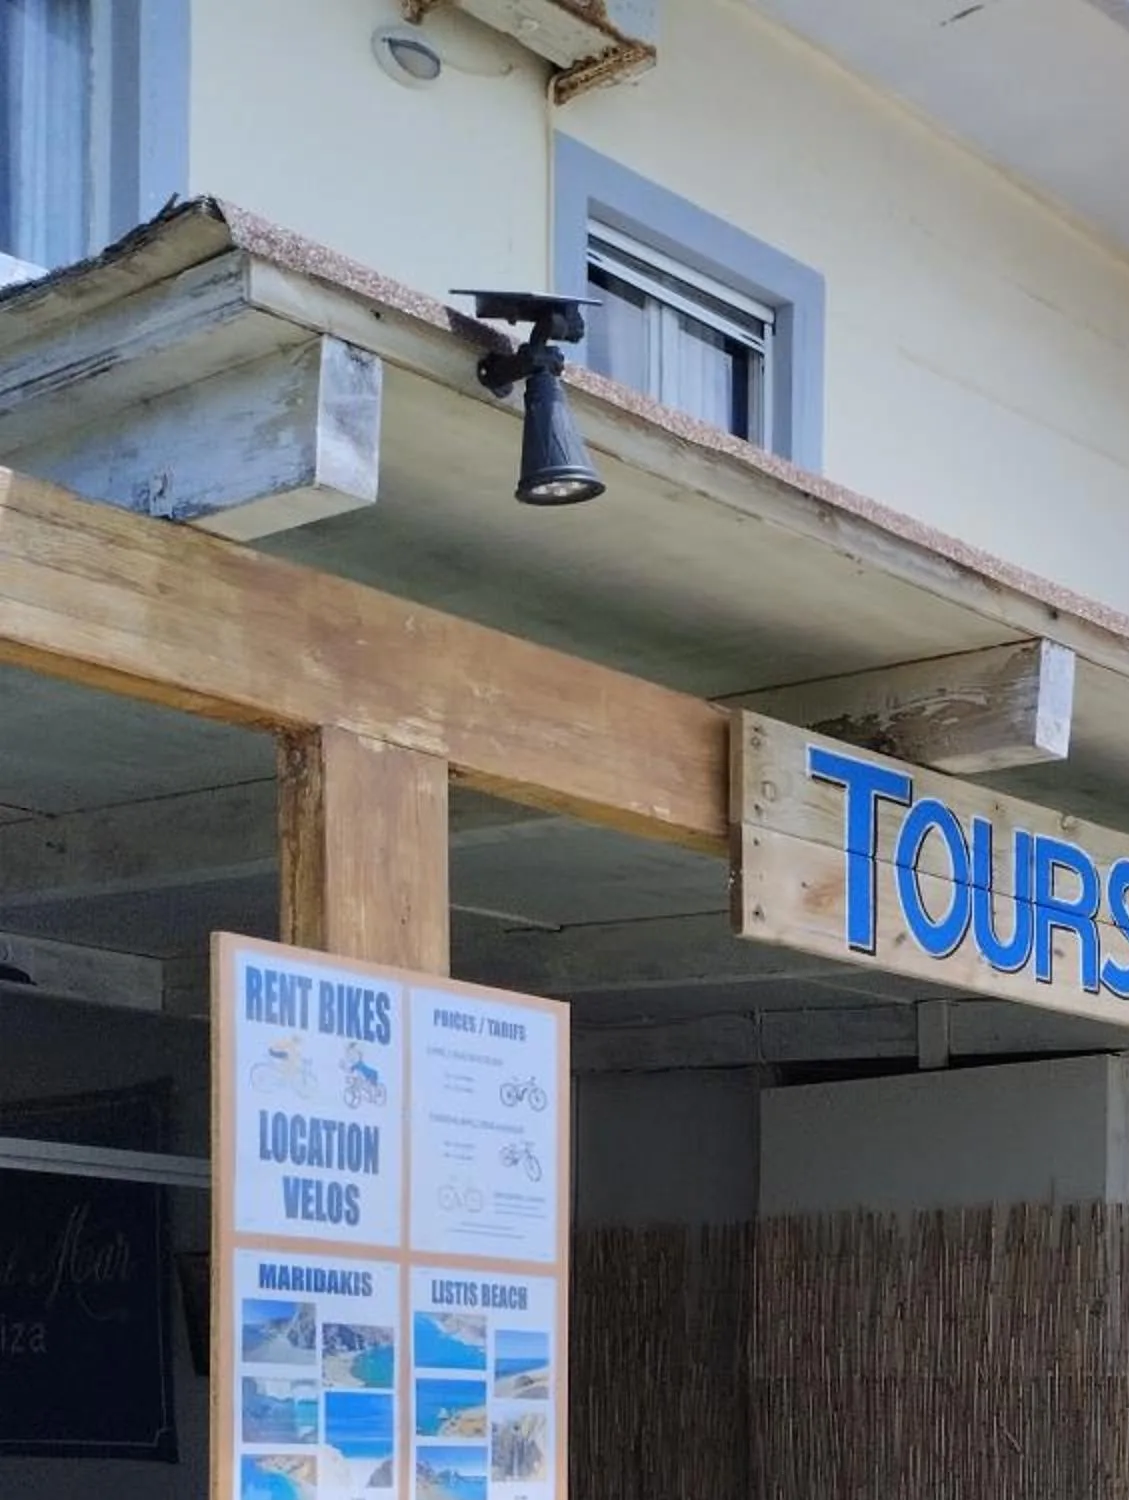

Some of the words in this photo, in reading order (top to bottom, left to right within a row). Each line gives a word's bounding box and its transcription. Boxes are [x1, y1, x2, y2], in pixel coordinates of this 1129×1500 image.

[245, 965, 313, 1030] RENT
[318, 979, 391, 1046] BIKES
[434, 1008, 476, 1034] PRICES
[258, 1109, 380, 1175] LOCATION
[283, 1175, 361, 1227] VELOS
[258, 1262, 373, 1298] MARIDAKIS
[431, 1278, 479, 1308] LISTIS
[481, 1283, 529, 1311] BEACH
